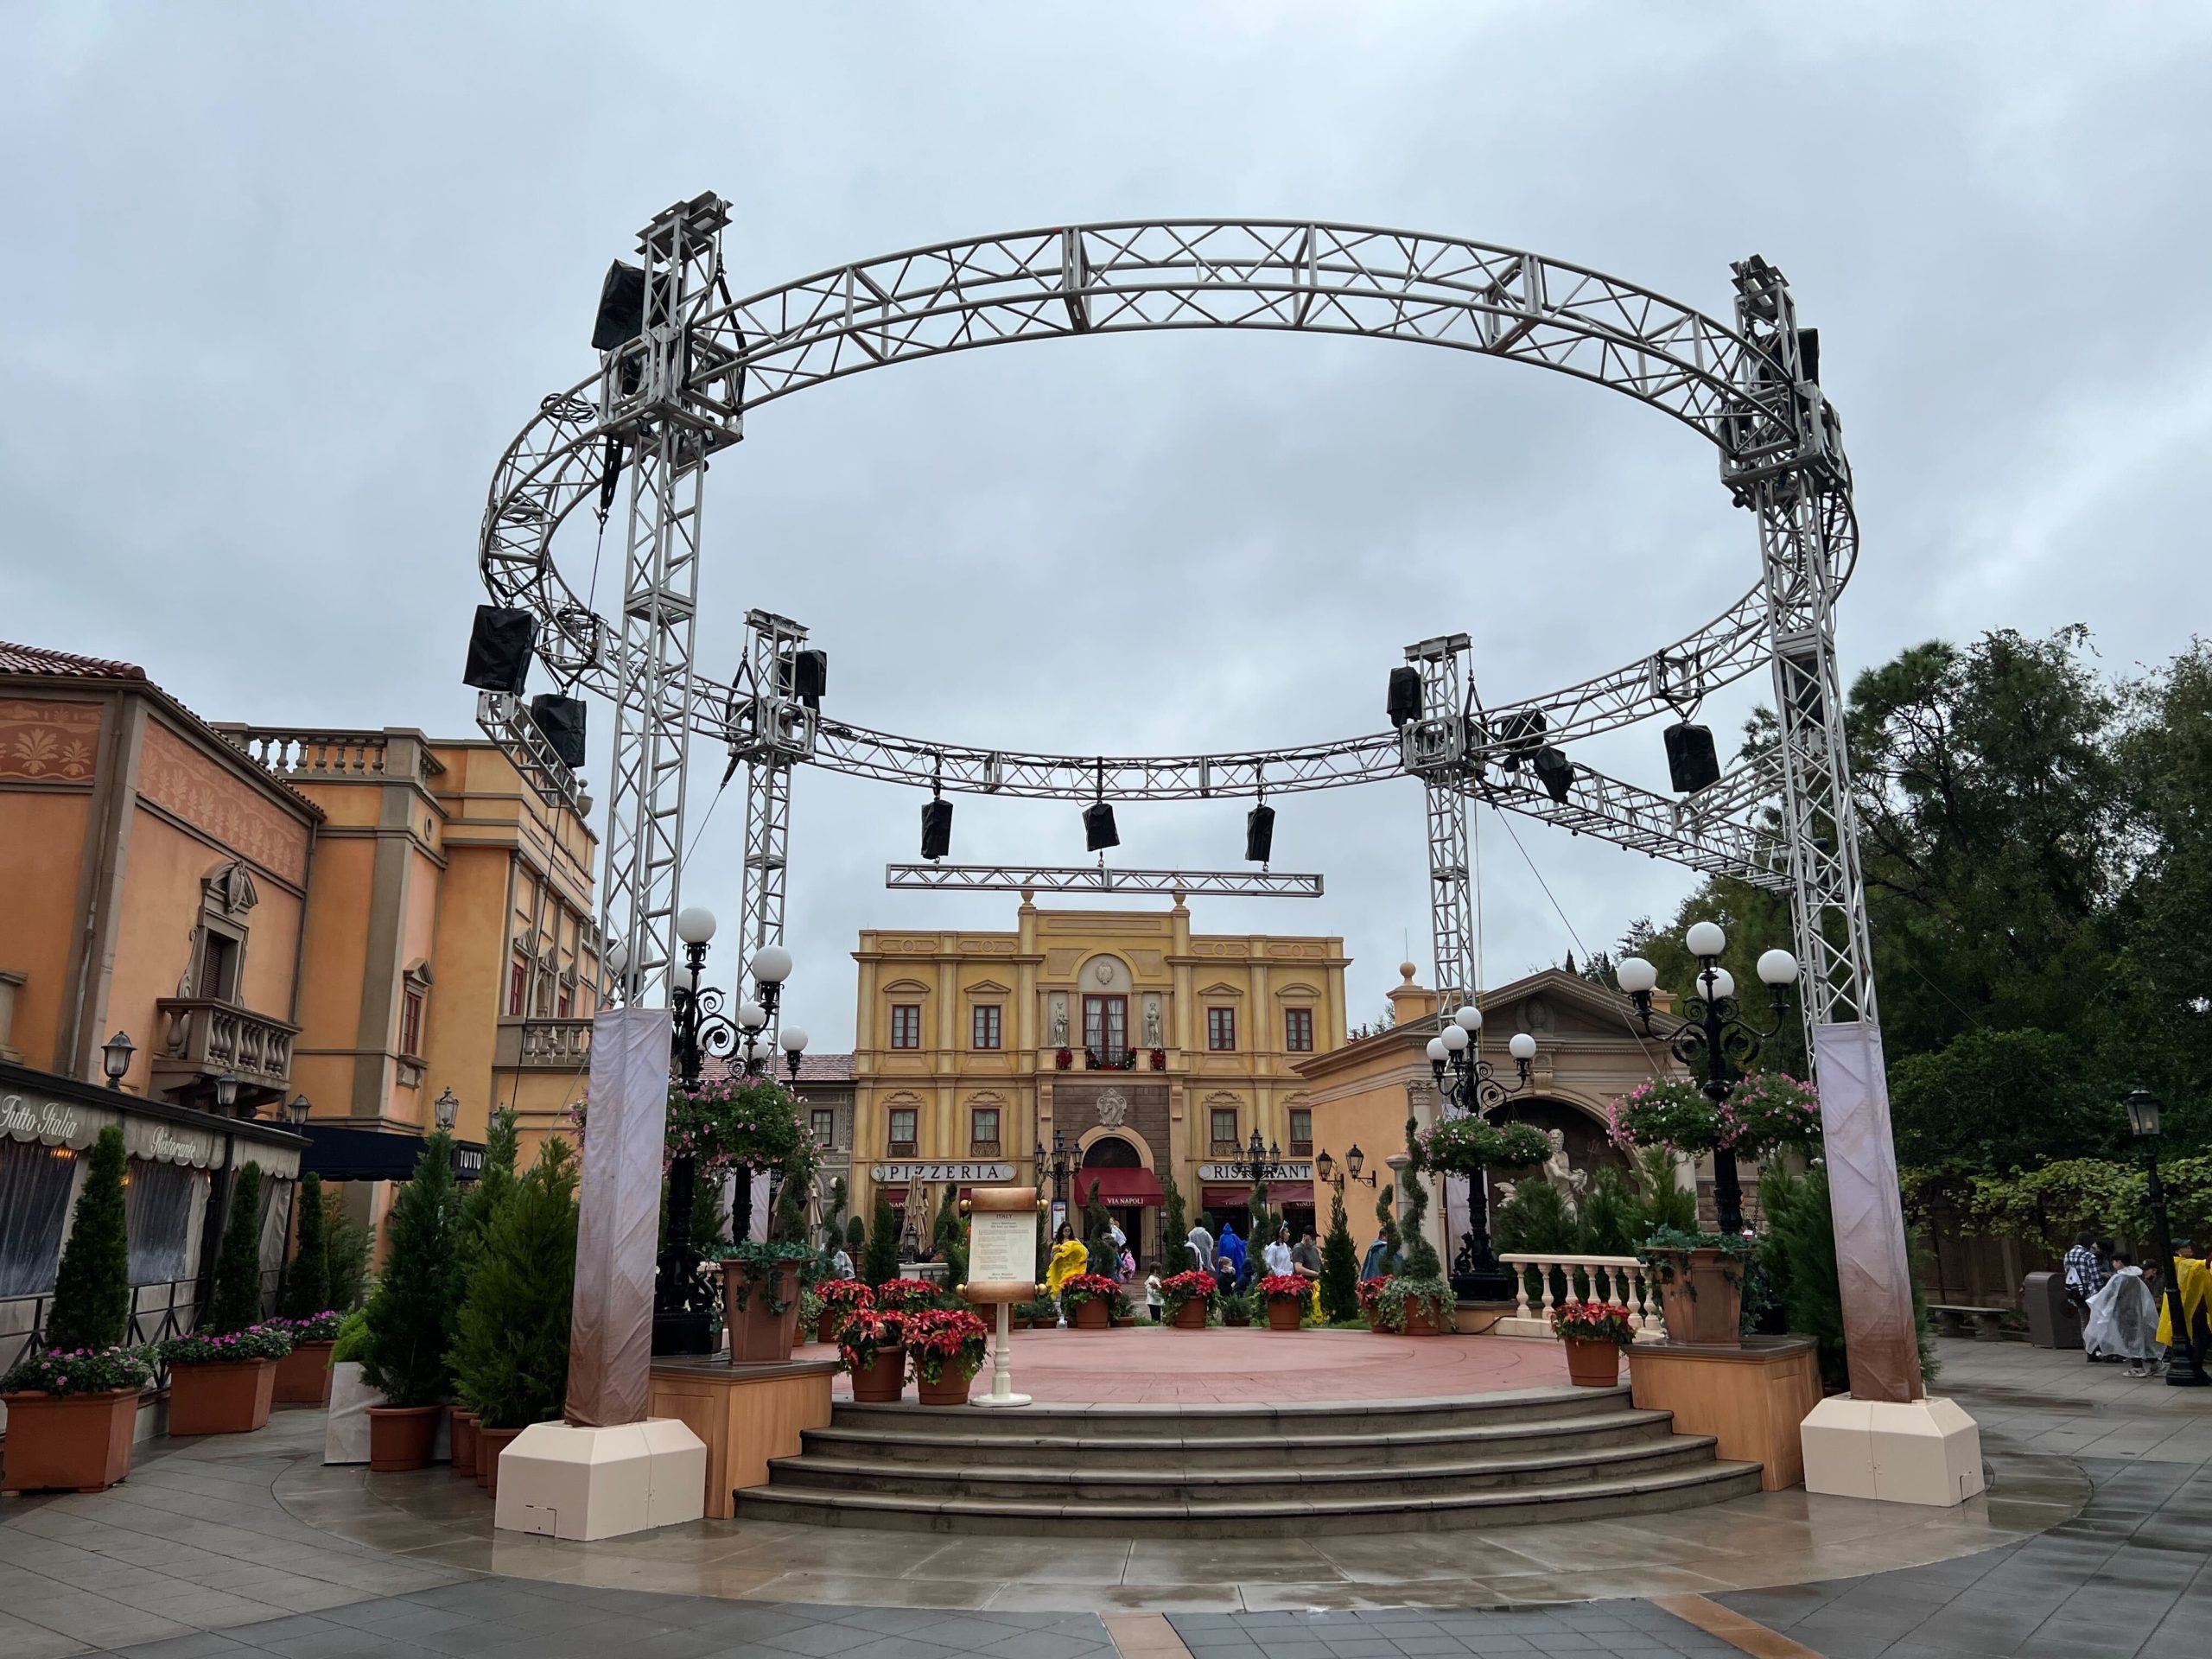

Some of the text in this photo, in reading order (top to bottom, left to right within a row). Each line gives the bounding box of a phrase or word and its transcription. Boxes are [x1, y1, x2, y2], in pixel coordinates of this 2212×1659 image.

[0, 1095, 78, 1139] Tutto Italia
[150, 1126, 196, 1159] Ristorante
[460, 1150, 482, 1170] TUTTO
[889, 1165, 999, 1179] PIZZERIA
[1214, 1165, 1311, 1179] RISTRANT
